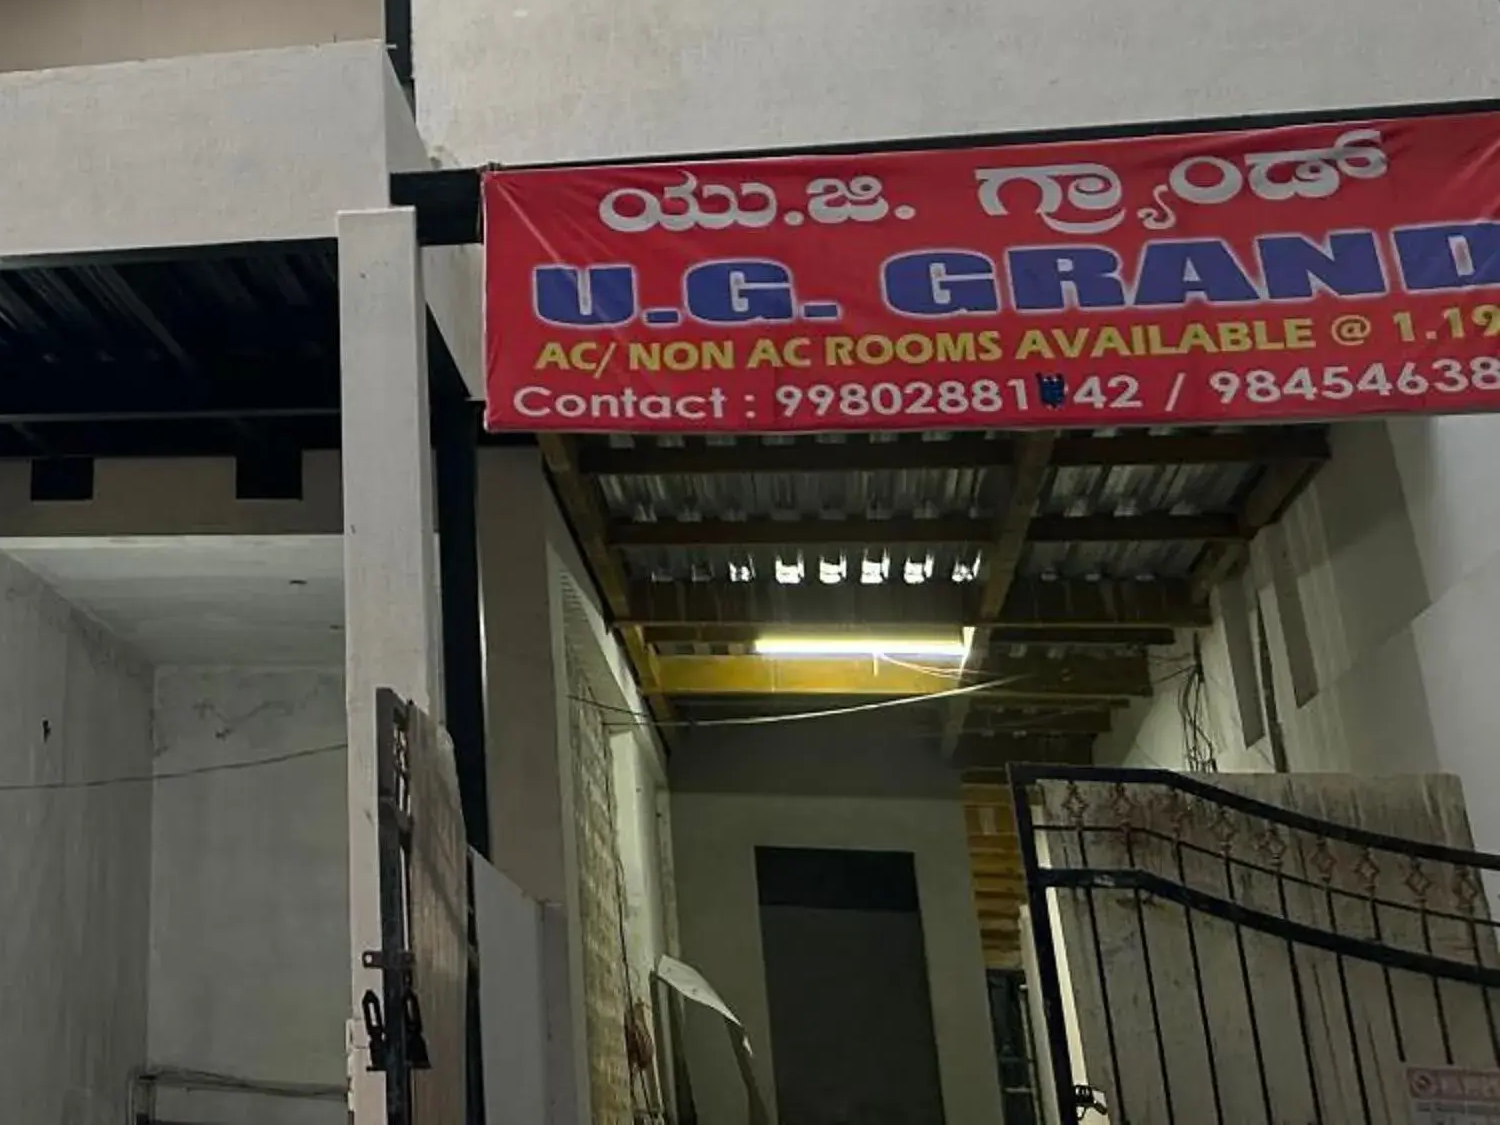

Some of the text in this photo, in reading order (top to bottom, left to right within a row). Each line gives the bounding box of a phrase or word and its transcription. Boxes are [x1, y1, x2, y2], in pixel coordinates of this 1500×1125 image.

[532, 220, 1500, 328] U.G. GRAND
[535, 341, 616, 378] AC/
[629, 340, 735, 371] NON
[746, 337, 812, 368] AC
[825, 329, 1003, 366] ROOMS
[1015, 317, 1316, 360] AVAILABLE
[1331, 314, 1372, 345] @
[513, 386, 726, 419] Contact
[775, 374, 1143, 419] 9980288142
[1209, 357, 1500, 404] 98454638
